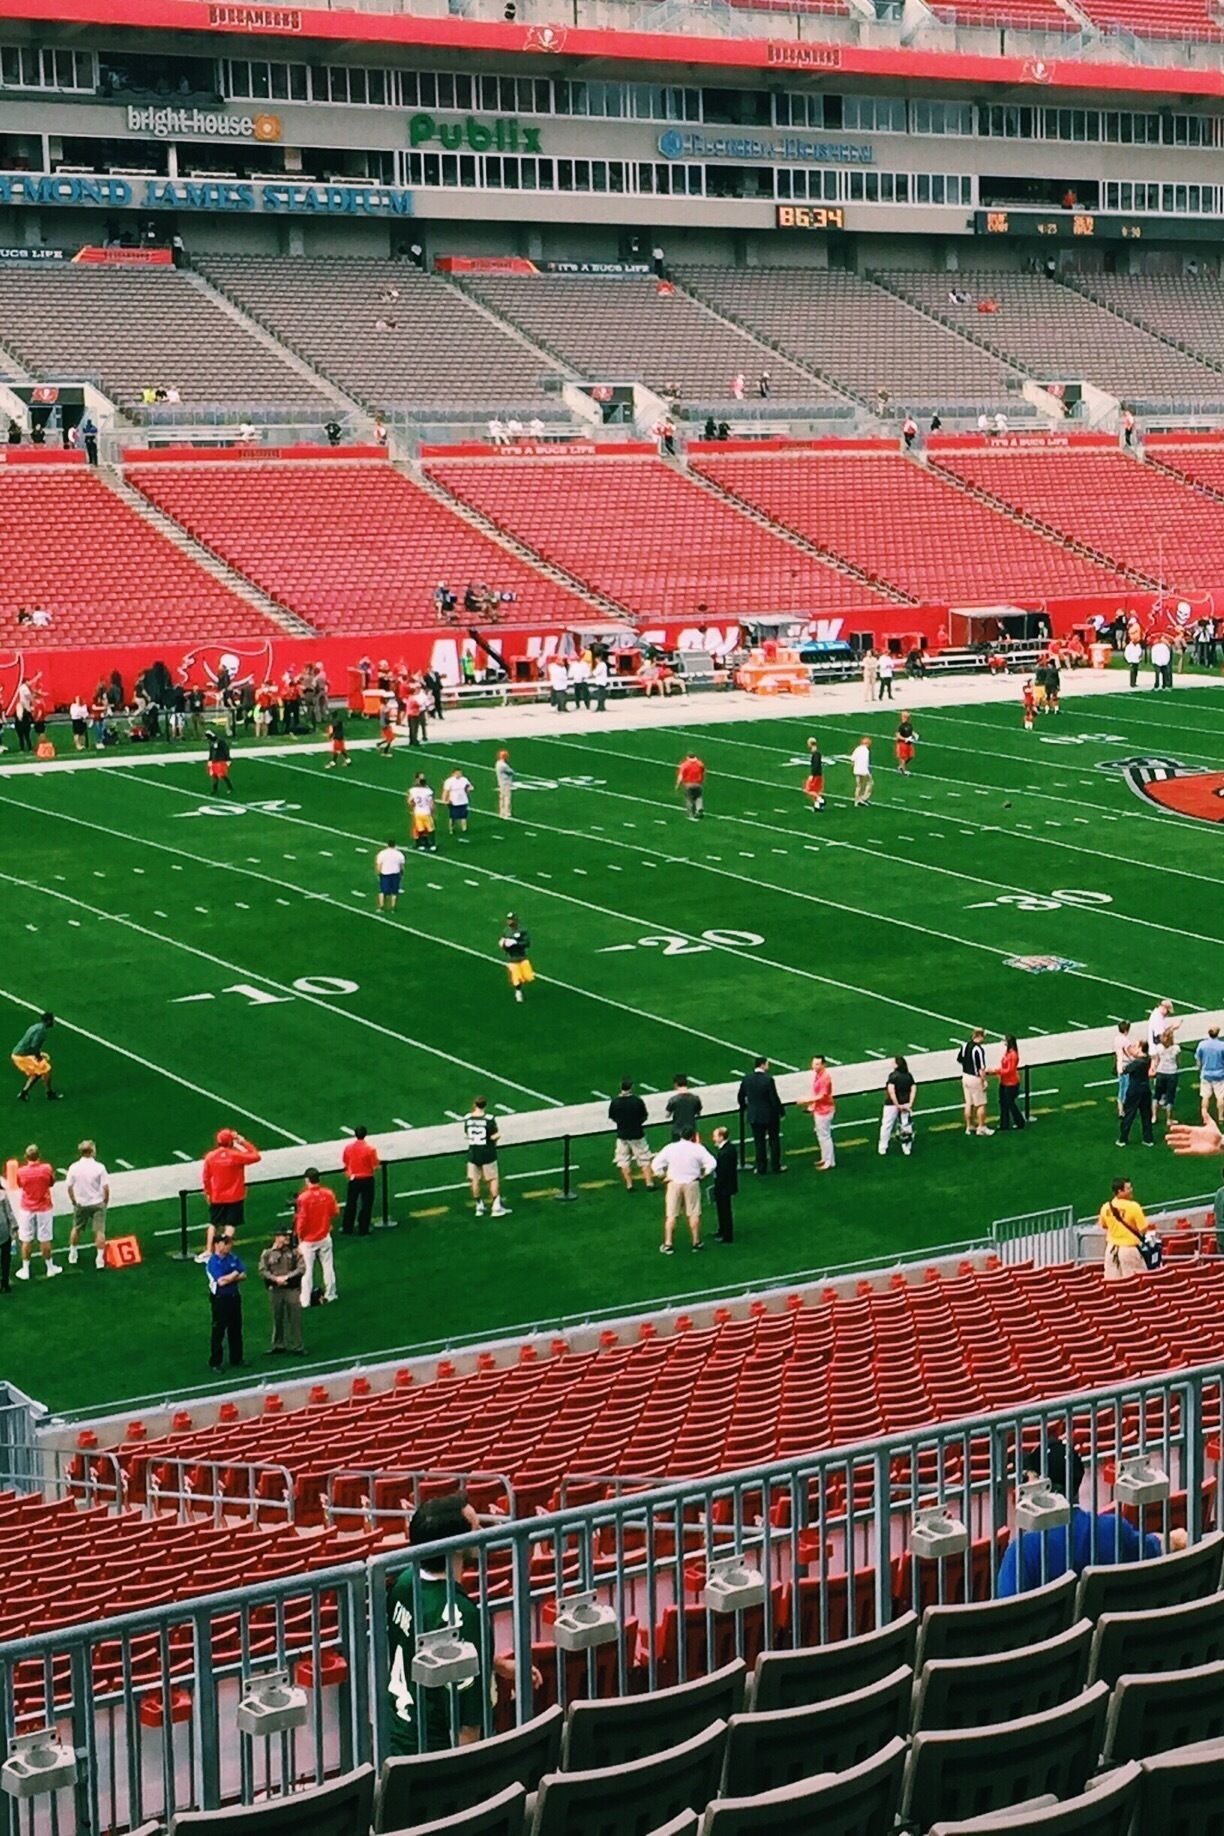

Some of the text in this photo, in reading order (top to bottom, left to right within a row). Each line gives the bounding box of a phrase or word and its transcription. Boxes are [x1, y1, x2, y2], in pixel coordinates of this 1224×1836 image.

[127, 105, 253, 137] bright house
[409, 113, 543, 153] Publix
[142, 180, 254, 209] JAMES
[262, 184, 414, 216] STADIUM
[32, 251, 63, 259] LIFE
[581, 264, 590, 272] A
[625, 265, 649, 273] LIFE
[117, 1241, 136, 1264] G
